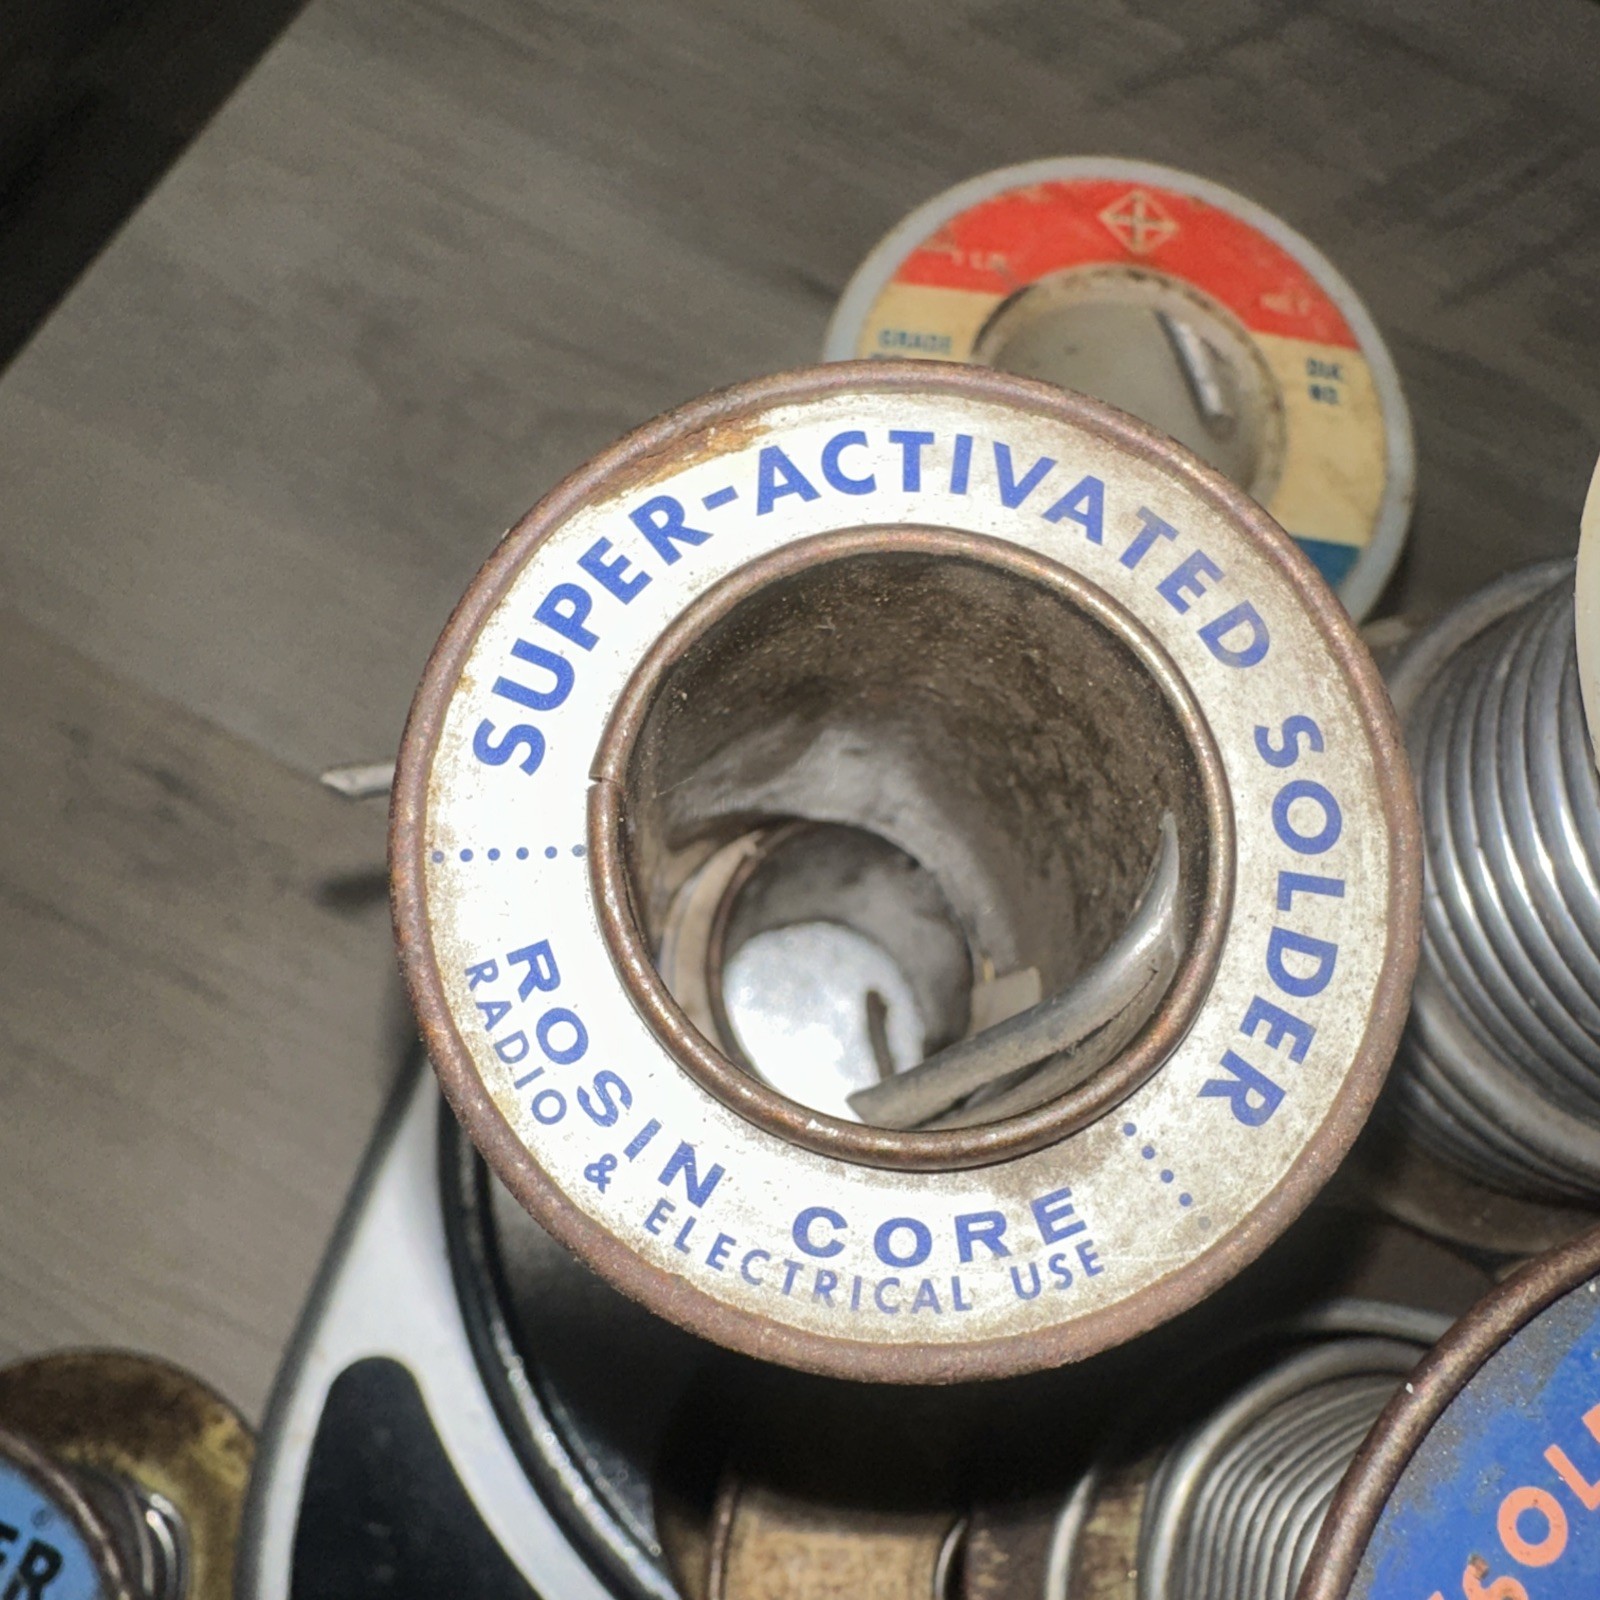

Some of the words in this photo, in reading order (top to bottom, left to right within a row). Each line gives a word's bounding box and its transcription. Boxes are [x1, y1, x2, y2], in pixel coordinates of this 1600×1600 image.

[472, 429, 1270, 775] SUPER-ACTIVATED
[1196, 714, 1346, 1128] SOLDER
[465, 958, 568, 1126] RADIO
[583, 1152, 618, 1194] &
[642, 1198, 973, 1315] ELECTRICAL
[1009, 1239, 1105, 1302] USE
[506, 938, 726, 1209] ROSIN
[791, 1186, 1088, 1269] CORE
